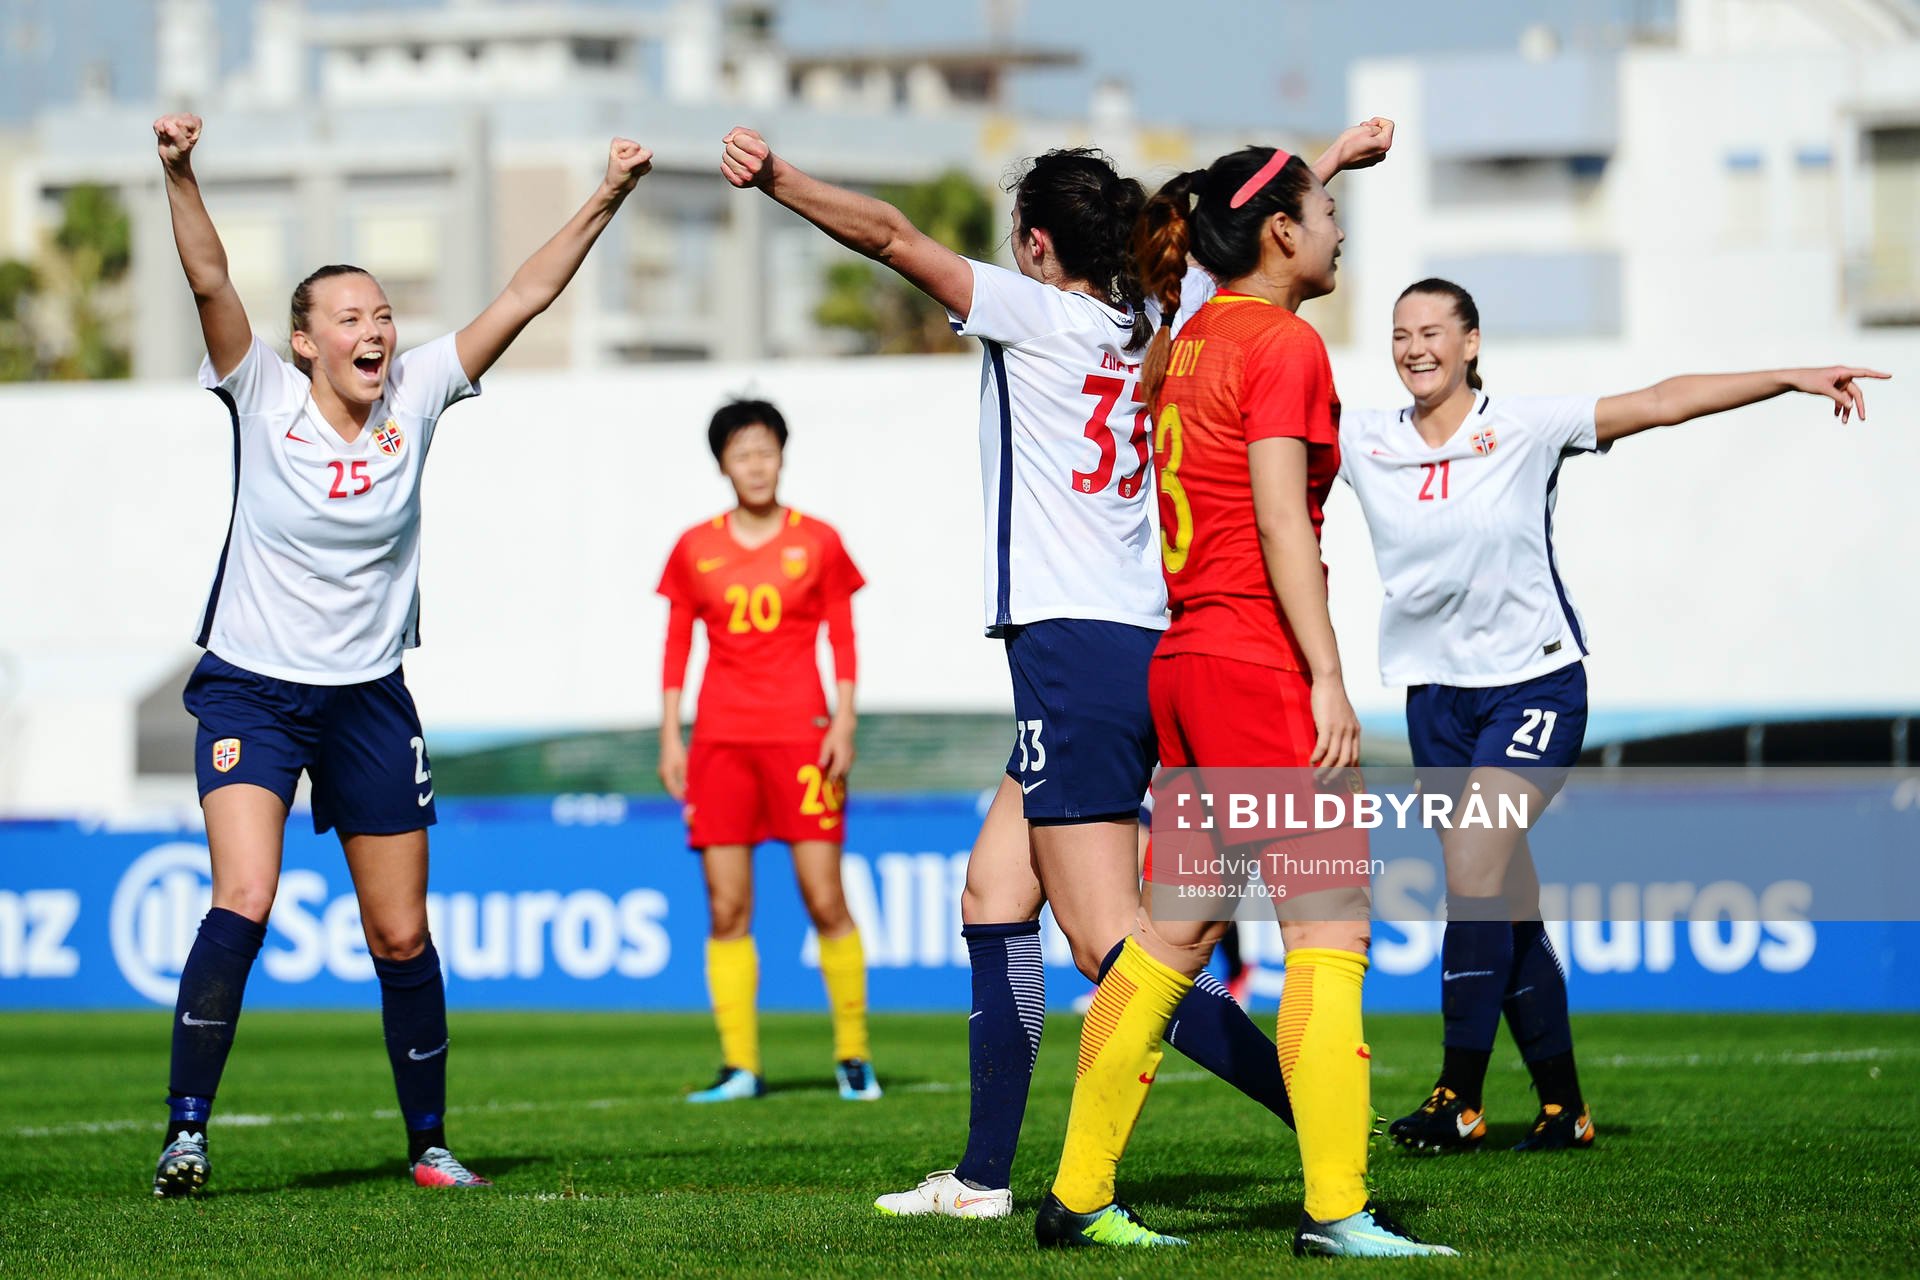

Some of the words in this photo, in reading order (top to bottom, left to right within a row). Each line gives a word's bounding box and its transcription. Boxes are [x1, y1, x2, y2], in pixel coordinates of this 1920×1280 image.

[328, 461, 371, 499] 25
[1418, 460, 1450, 500] 21
[725, 584, 781, 633] 20
[1018, 720, 1046, 772] 33
[1512, 709, 1557, 752] 21
[410, 736, 432, 784] 2
